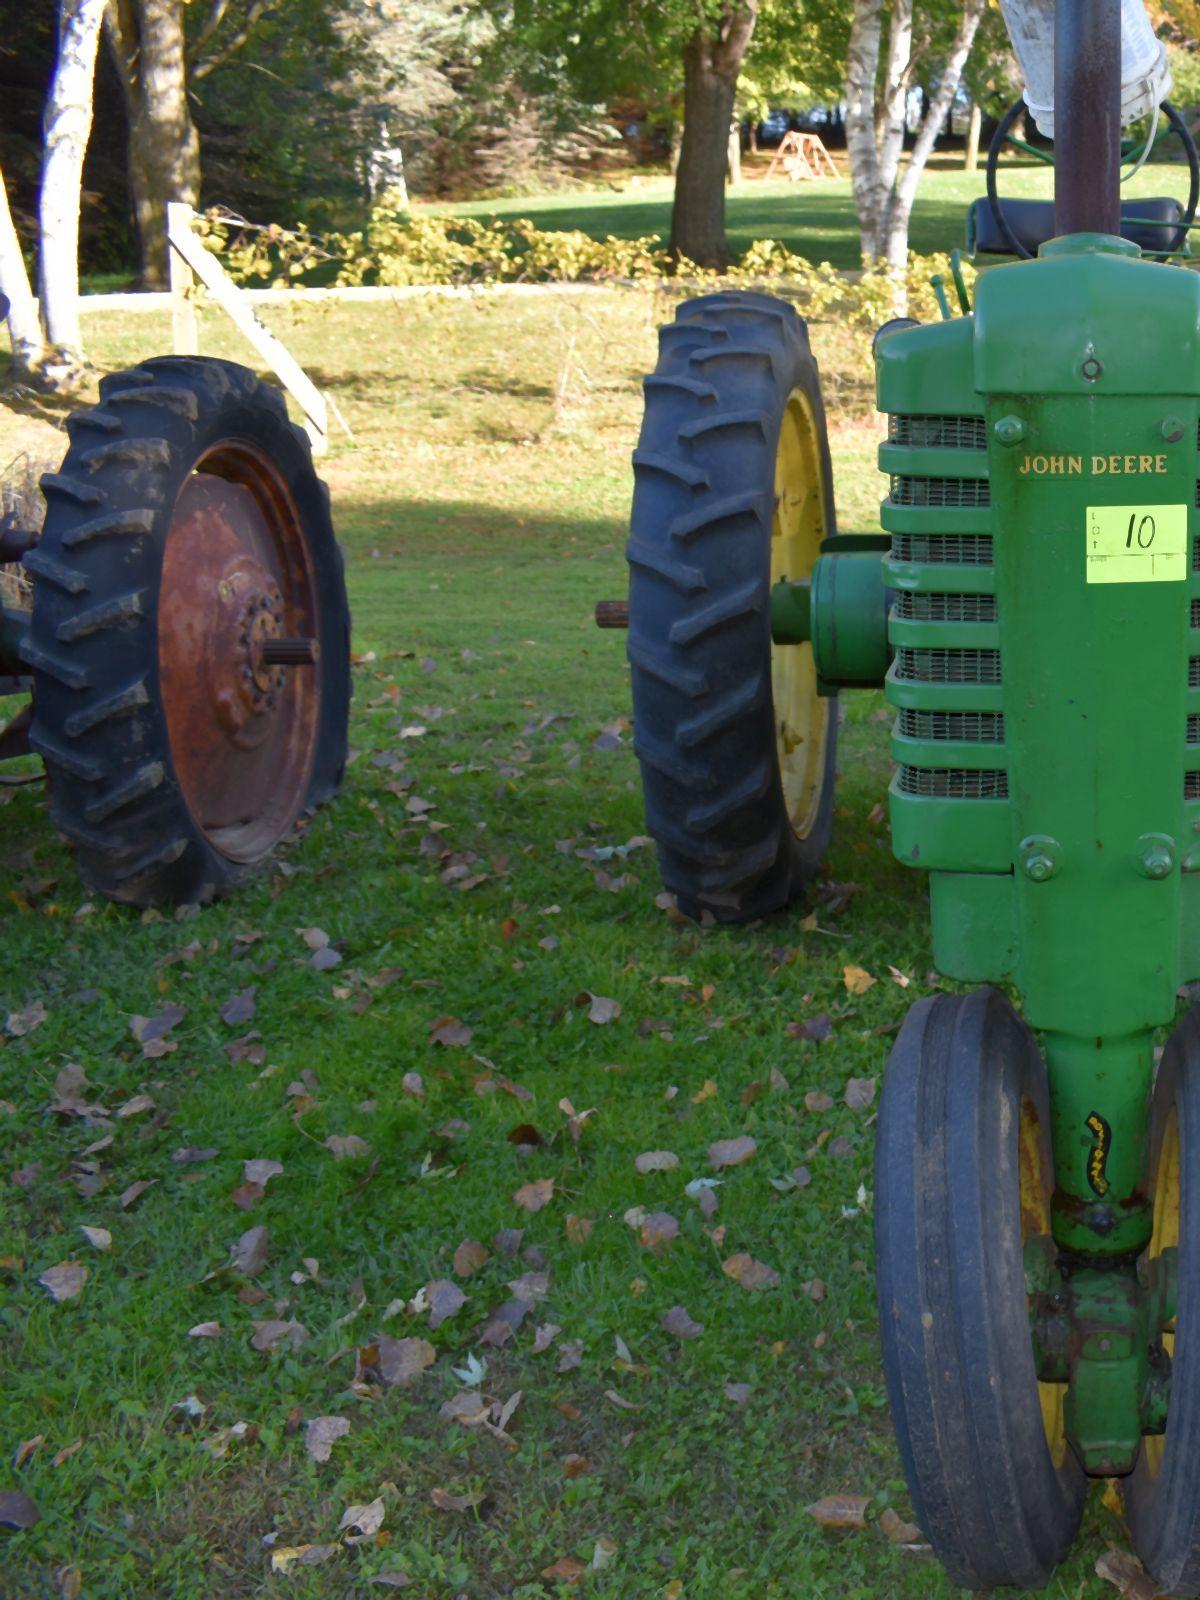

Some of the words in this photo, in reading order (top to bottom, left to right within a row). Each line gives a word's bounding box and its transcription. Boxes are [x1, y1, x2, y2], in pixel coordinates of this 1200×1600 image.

[1019, 455, 1082, 474] JOHN
[1091, 454, 1168, 475] DEERE
[1126, 513, 1156, 548] 10
